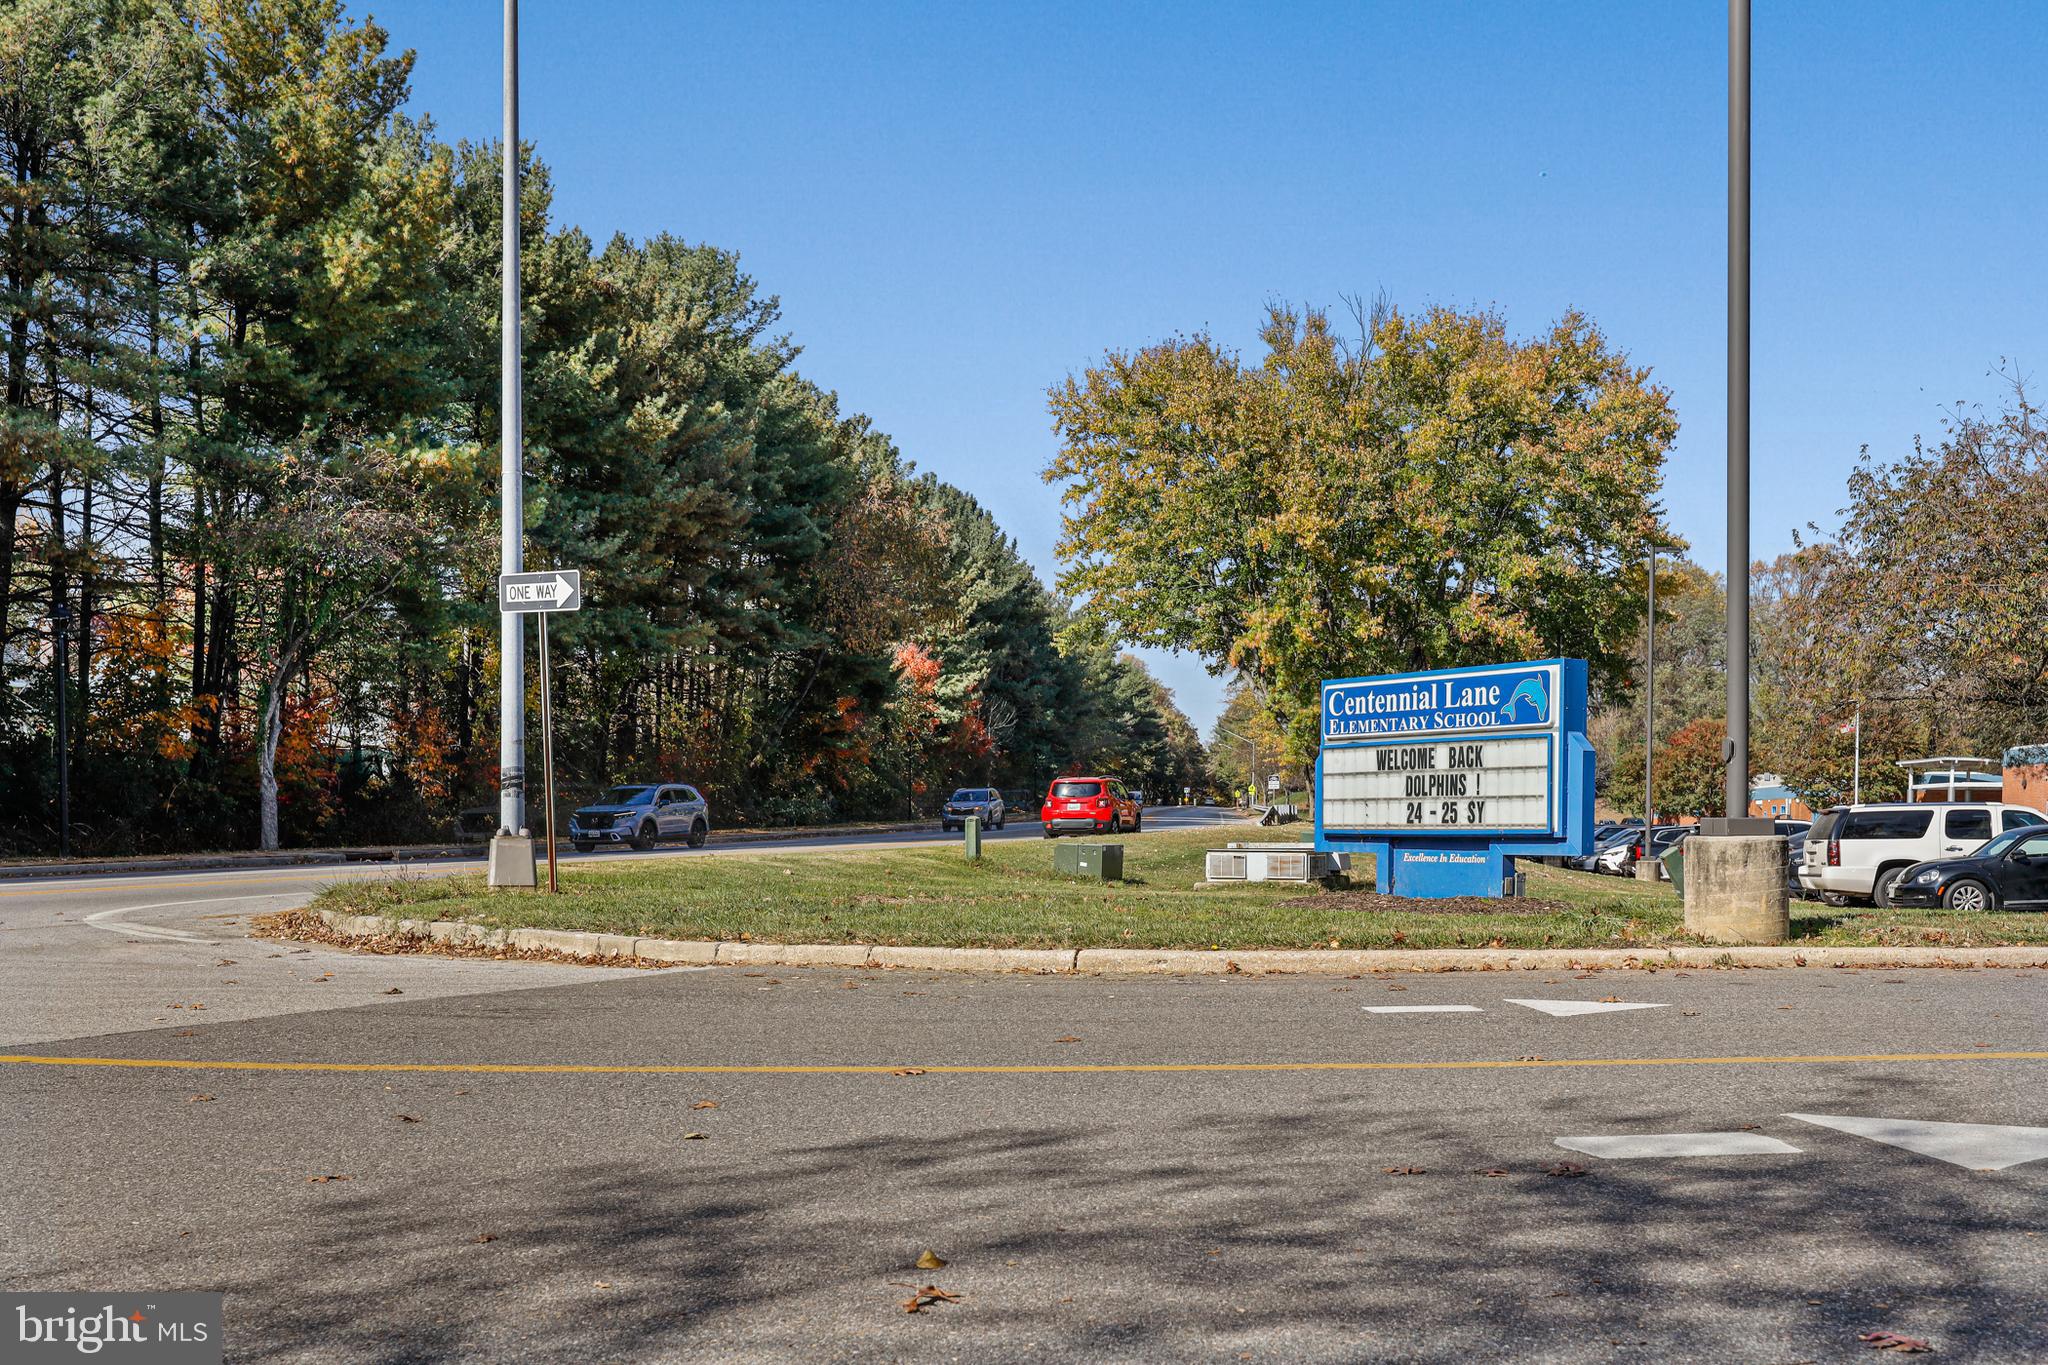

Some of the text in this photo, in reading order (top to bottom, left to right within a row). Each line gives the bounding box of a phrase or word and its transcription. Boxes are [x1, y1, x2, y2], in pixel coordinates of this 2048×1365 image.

[509, 584, 557, 600] ONE WAY
[1328, 681, 1500, 716] Centennial Lane
[1329, 711, 1500, 735] ELEMENTARY SCHOOL
[1376, 745, 1483, 771] WELCOME BACK
[1405, 773, 1467, 797] DOLPHINS
[1406, 802, 1422, 824] 24
[1441, 801, 1458, 824] 25
[1467, 800, 1485, 824] SY
[1403, 852, 1486, 864] Excellence In Education
